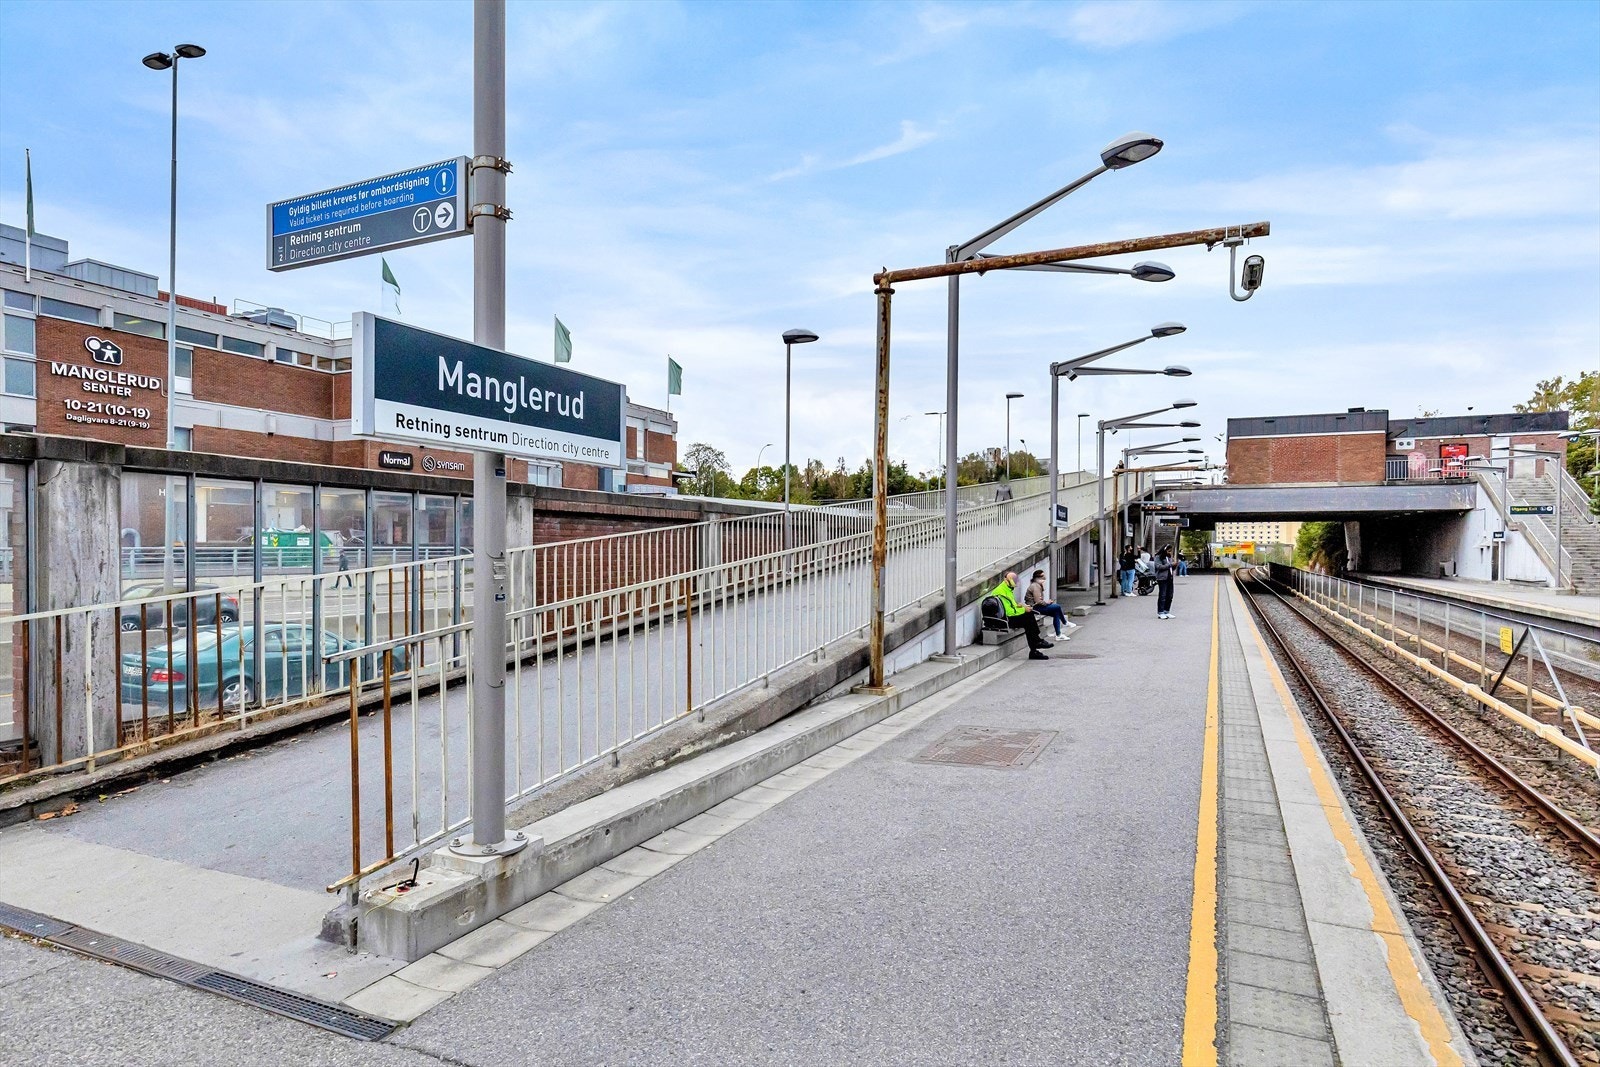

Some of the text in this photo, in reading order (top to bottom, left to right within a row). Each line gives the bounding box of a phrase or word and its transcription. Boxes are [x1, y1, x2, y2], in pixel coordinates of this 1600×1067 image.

[288, 175, 430, 217] Gyldig billett kreves før ombordstigning
[289, 192, 414, 227] Valid ticket is required before boarding
[290, 223, 361, 246] Retning sentrum
[290, 236, 371, 260] Direction city centre
[51, 362, 160, 390] MANGLERUD
[438, 355, 584, 420] Manglerud
[83, 382, 132, 397] SENTER
[64, 399, 150, 419] 10-21 (10-19)
[66, 413, 150, 429] Dagligvare 8-21 (9-19)
[395, 413, 610, 460] Retning sentrum Direction city centre
[383, 453, 411, 466] Normal
[436, 460, 465, 471] SYNSAM
